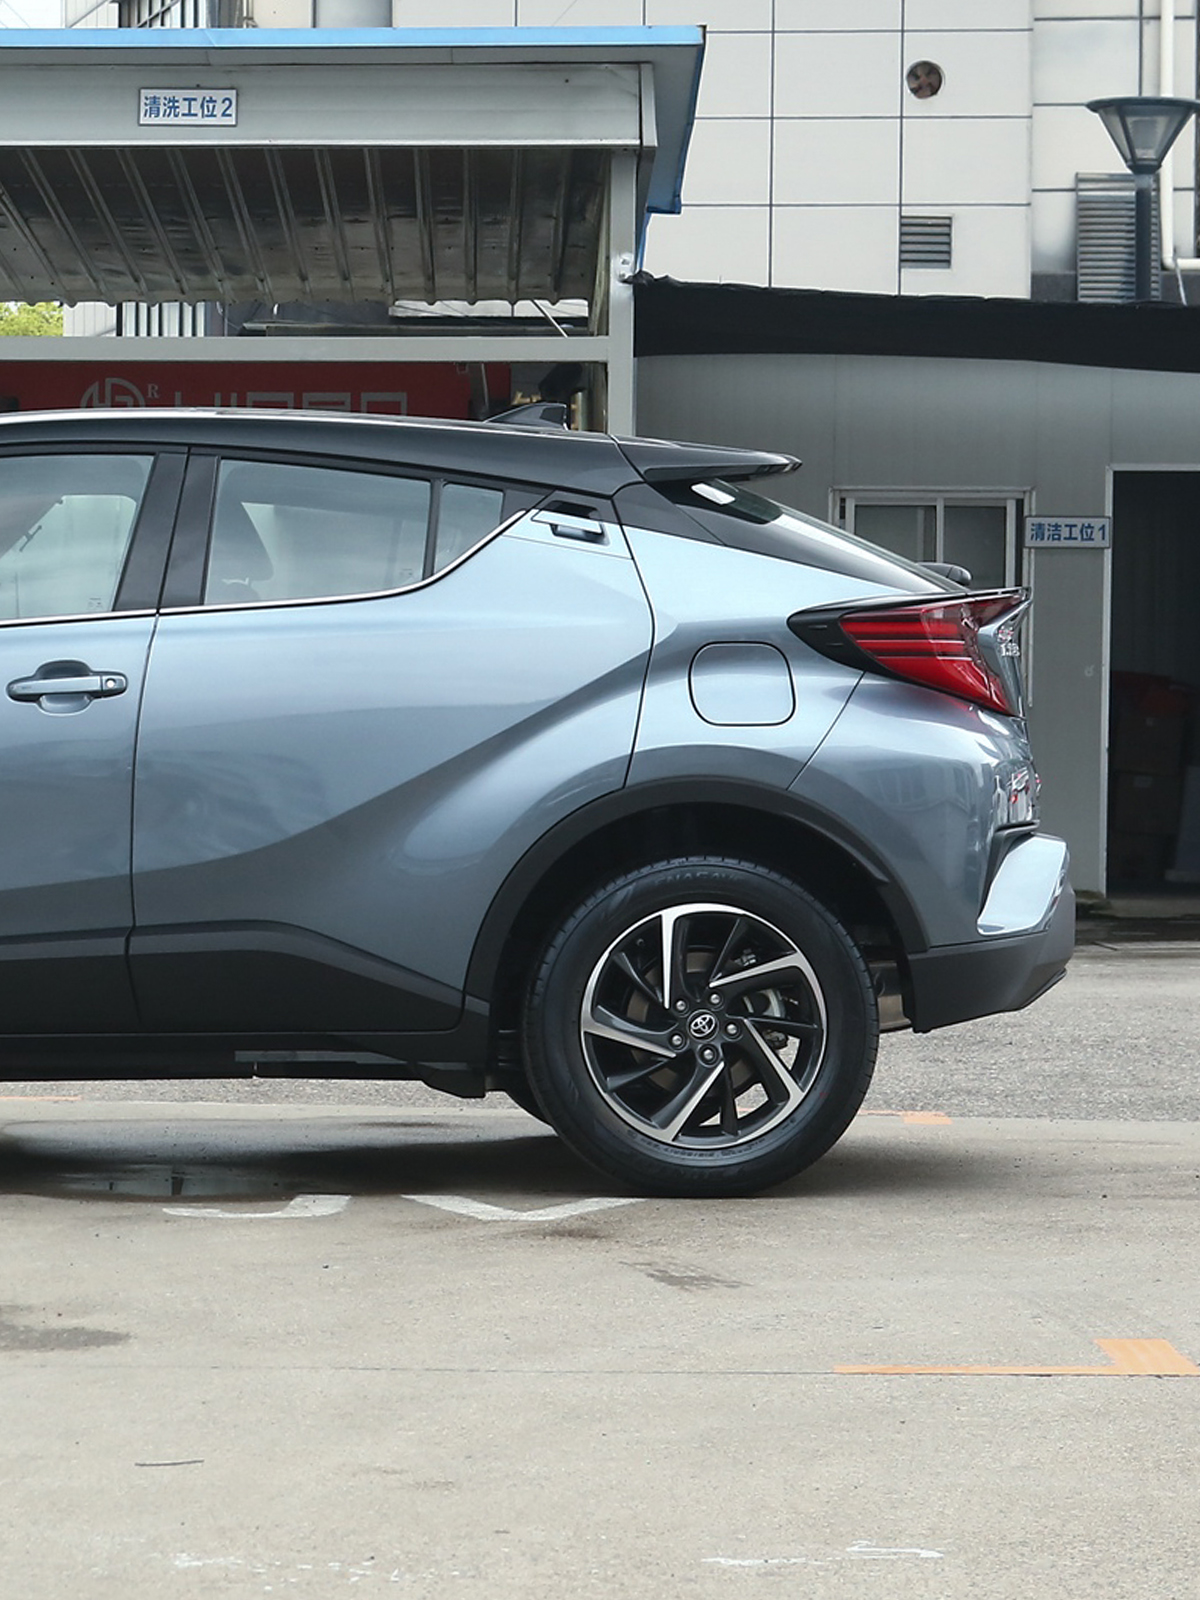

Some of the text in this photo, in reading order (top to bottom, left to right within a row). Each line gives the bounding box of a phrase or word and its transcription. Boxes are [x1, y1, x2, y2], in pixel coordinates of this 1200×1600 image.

[144, 95, 233, 118] 清洗工位2
[1031, 522, 1106, 541] 清洁工位1
